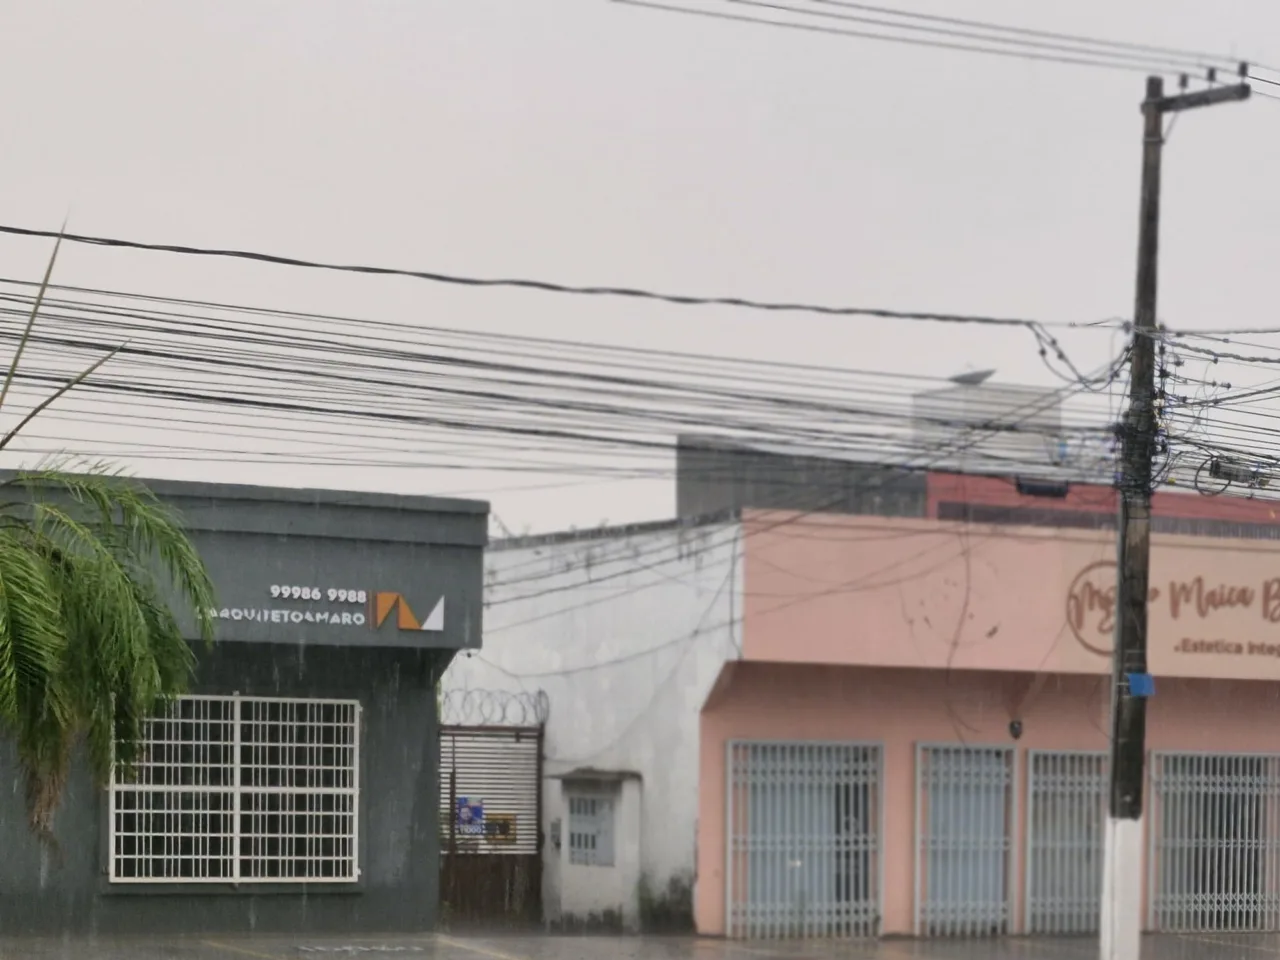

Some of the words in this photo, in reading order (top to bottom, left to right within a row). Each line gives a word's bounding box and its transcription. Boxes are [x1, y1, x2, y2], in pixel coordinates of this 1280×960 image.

[269, 584, 321, 601] 99986
[327, 587, 367, 604] 9988
[1168, 575, 1255, 620] Maica
[196, 606, 366, 625] ARQUITETOAMARO
